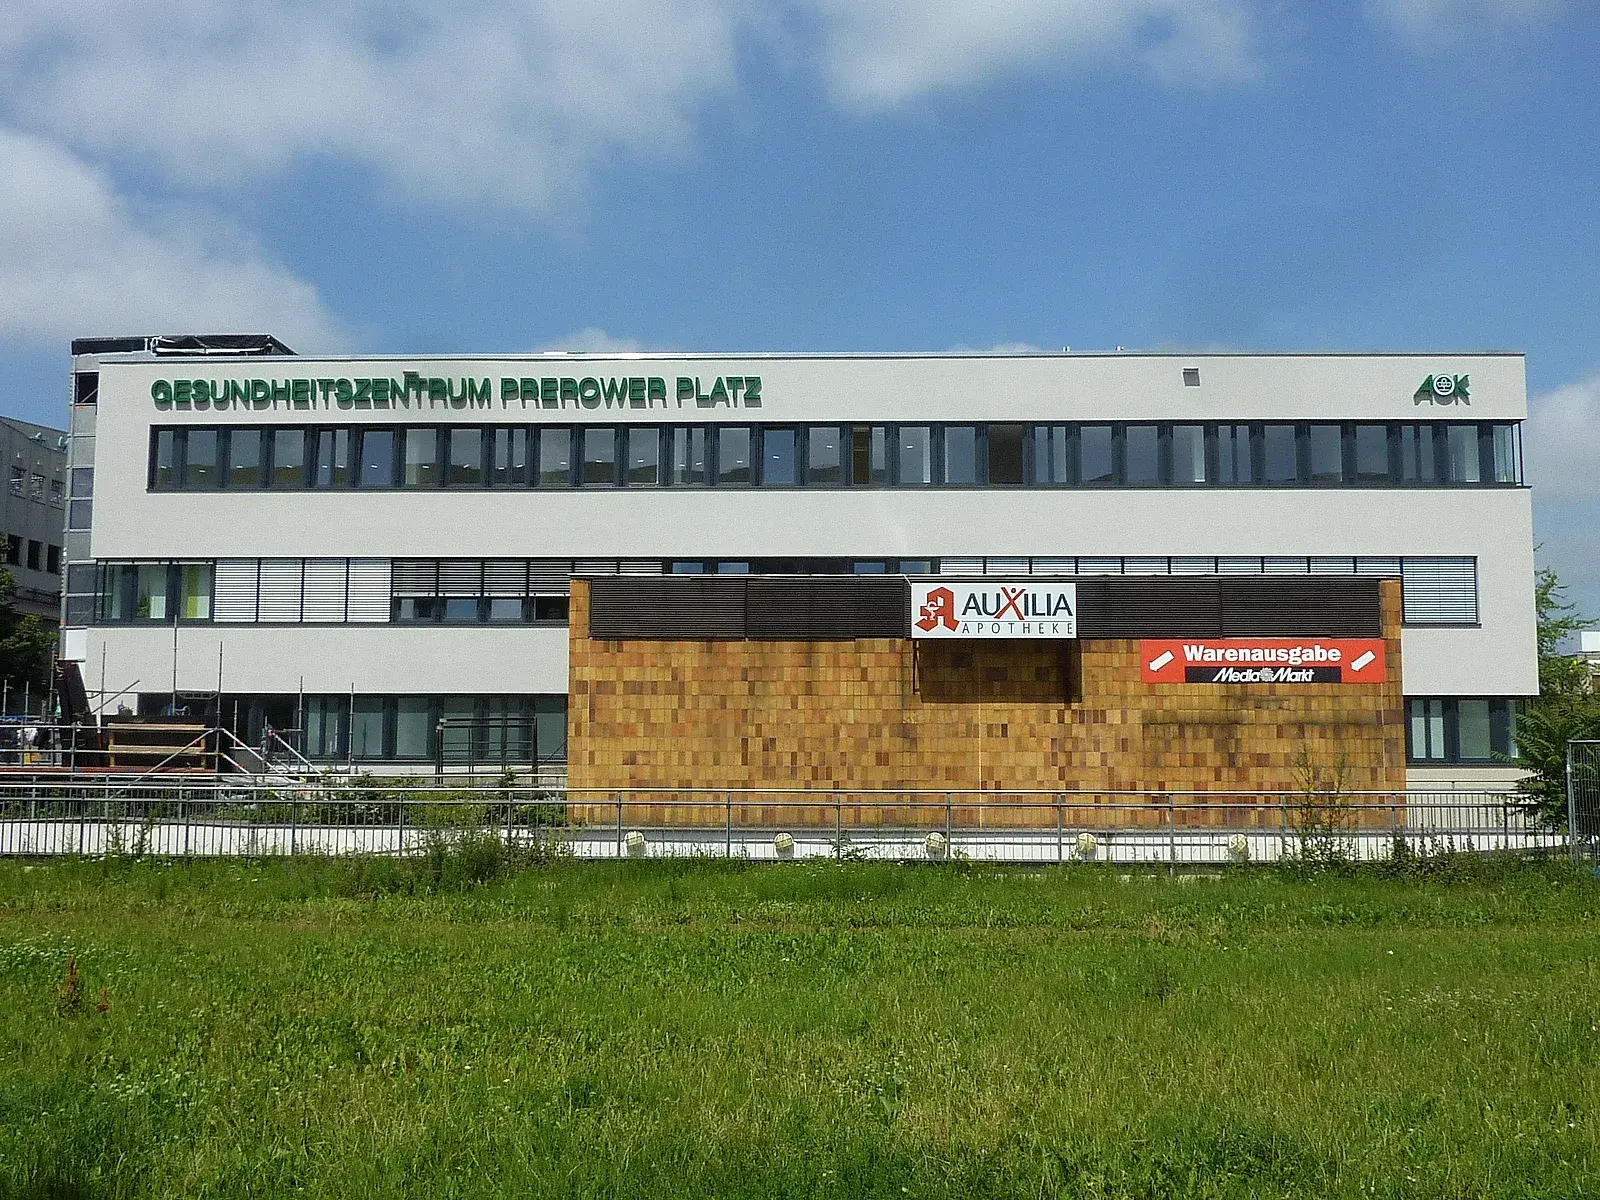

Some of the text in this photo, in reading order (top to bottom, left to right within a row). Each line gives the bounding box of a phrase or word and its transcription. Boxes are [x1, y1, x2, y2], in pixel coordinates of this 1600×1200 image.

[151, 376, 762, 402] GESUNDHEITSZENTRUM PREROWER PLATZ
[1413, 374, 1471, 397] AOK
[961, 586, 1074, 620] AUXILIA
[962, 622, 1073, 634] APOTHEKE
[1182, 644, 1342, 665] Warenausgabe
[1212, 667, 1315, 682] Media Markt
